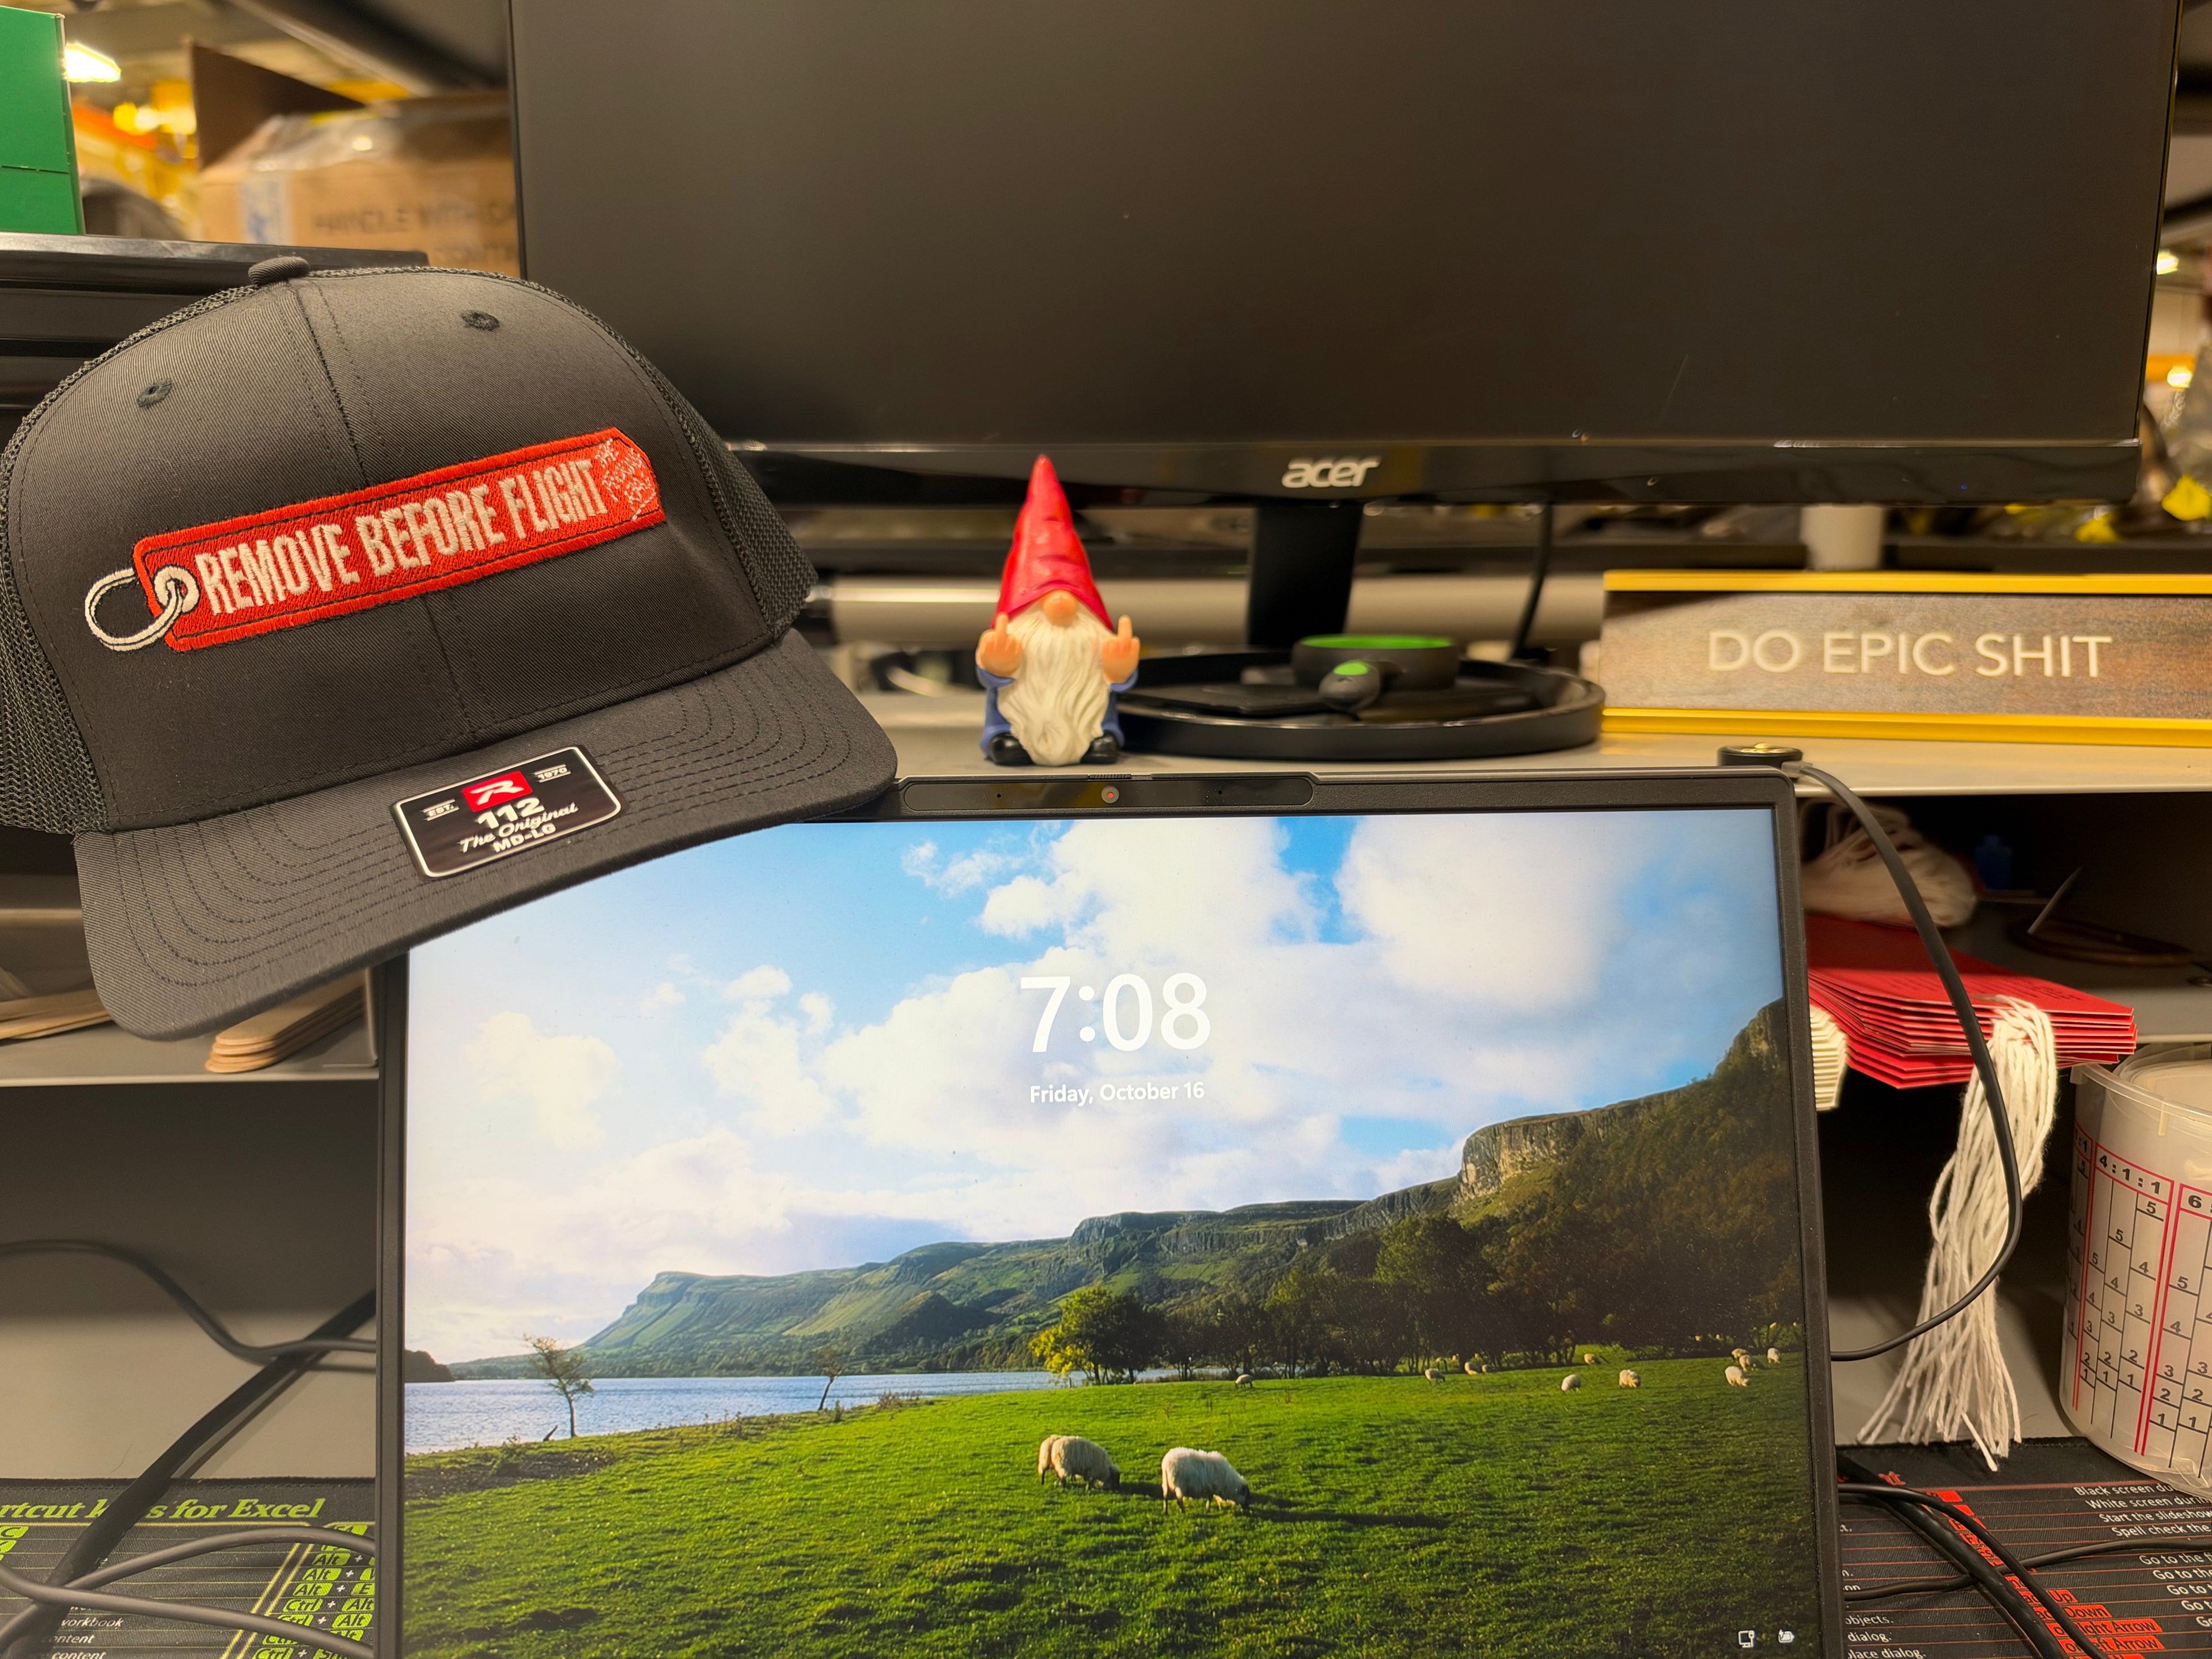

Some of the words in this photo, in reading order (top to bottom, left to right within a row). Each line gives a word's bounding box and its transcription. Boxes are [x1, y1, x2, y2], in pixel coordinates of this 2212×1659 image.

[1282, 460, 1381, 488] acer
[194, 524, 361, 616] REMOVE
[354, 483, 506, 577] BEFORE
[497, 459, 608, 540] FLIGHT
[1708, 629, 1804, 673] DO
[1823, 632, 1957, 676] EPIC
[1975, 632, 2112, 677] SHIT
[428, 803, 455, 818] EST.
[478, 797, 545, 830] 112
[457, 832, 496, 854] The
[498, 802, 579, 838] Original
[493, 823, 556, 853] MD-LG
[1020, 972, 1211, 1052] 7:08
[1030, 1084, 1094, 1107] Friday,
[1100, 1082, 1179, 1101] October
[1184, 1082, 1205, 1099] 16
[2146, 1201, 2157, 1214] 5
[2115, 1229, 2124, 1242] 5
[2092, 1252, 2099, 1265] 5
[2139, 1262, 2149, 1274] 4
[2111, 1277, 2119, 1288] 4
[2177, 1276, 2188, 1289] 5
[2089, 1292, 2094, 1304] 4
[2134, 1304, 2143, 1317] 3
[2108, 1312, 2115, 1324] 3
[2086, 1320, 2092, 1332] 3
[2170, 1321, 2181, 1334] 4
[2084, 1353, 2090, 1365] 2
[2104, 1351, 2111, 1364] 2
[2130, 1350, 2138, 1363] 2
[2164, 1365, 2174, 1378] 3
[2198, 1362, 2208, 1374] 3
[2103, 1371, 2108, 1382] 1
[2127, 1374, 2134, 1385] 1
[2160, 1388, 2171, 1401] 2
[2192, 1389, 2203, 1402] 2
[2158, 1413, 2165, 1425] 1
[2189, 1416, 2197, 1429] 1
[2074, 1486, 2111, 1496] Black
[2112, 1485, 2154, 1494] screen
[169, 1499, 228, 1519] for
[228, 1498, 326, 1518] Excel
[2085, 1499, 2127, 1509] White
[2129, 1498, 2173, 1507] screen
[2099, 1513, 2131, 1522] Start
[2132, 1512, 2154, 1521] the
[2155, 1510, 2212, 1520] slideshow
[2111, 1526, 2147, 1537] Spell
[2148, 1524, 2187, 1535] check
[2187, 1524, 2212, 1532] the
[313, 1554, 340, 1566] Alt
[2139, 1555, 2161, 1565] Go
[2161, 1555, 2178, 1564] to
[2179, 1553, 2205, 1563] the
[304, 1569, 331, 1581] Alt
[2153, 1570, 2175, 1580] Go
[2175, 1569, 2192, 1578] to
[294, 1584, 321, 1596] Alt
[359, 1584, 373, 1594] E
[2166, 1585, 2189, 1594] Go
[2189, 1584, 2207, 1594] to
[2048, 1590, 2073, 1602] Up
[286, 1599, 320, 1611] Ctrl
[347, 1599, 374, 1611] Alt
[2181, 1600, 2204, 1611] Go
[2065, 1606, 2109, 1618] Down
[338, 1615, 365, 1627] Alt
[2077, 1622, 2112, 1635] ight
[2111, 1621, 2157, 1633] Arrow
[1847, 1631, 1892, 1643] dialog.
[2112, 1638, 2158, 1649] Arrow
[254, 1648, 290, 1659] Ctrl
[1881, 1648, 1926, 1659] dialog.
